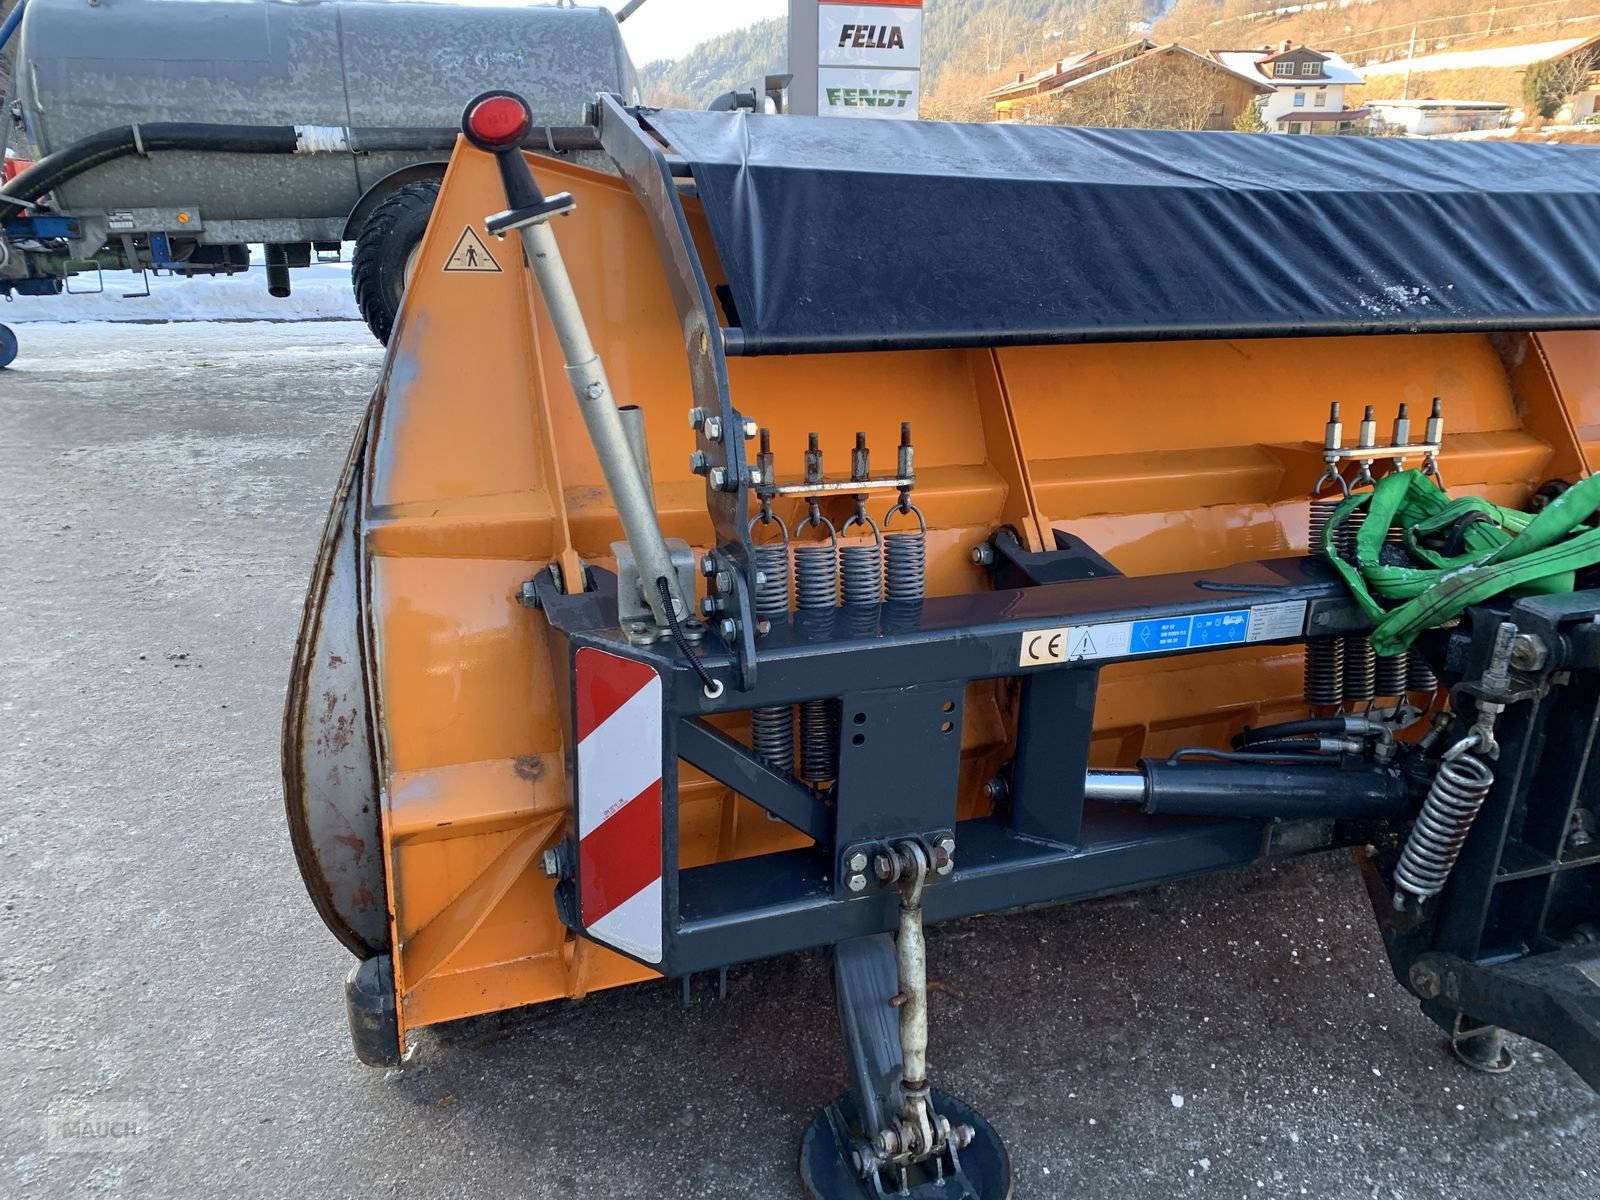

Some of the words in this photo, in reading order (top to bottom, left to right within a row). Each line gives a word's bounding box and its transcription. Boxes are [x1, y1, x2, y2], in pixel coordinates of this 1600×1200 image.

[838, 24, 904, 49] FELLA
[826, 88, 912, 108] FENDT
[1029, 633, 1061, 660] CE
